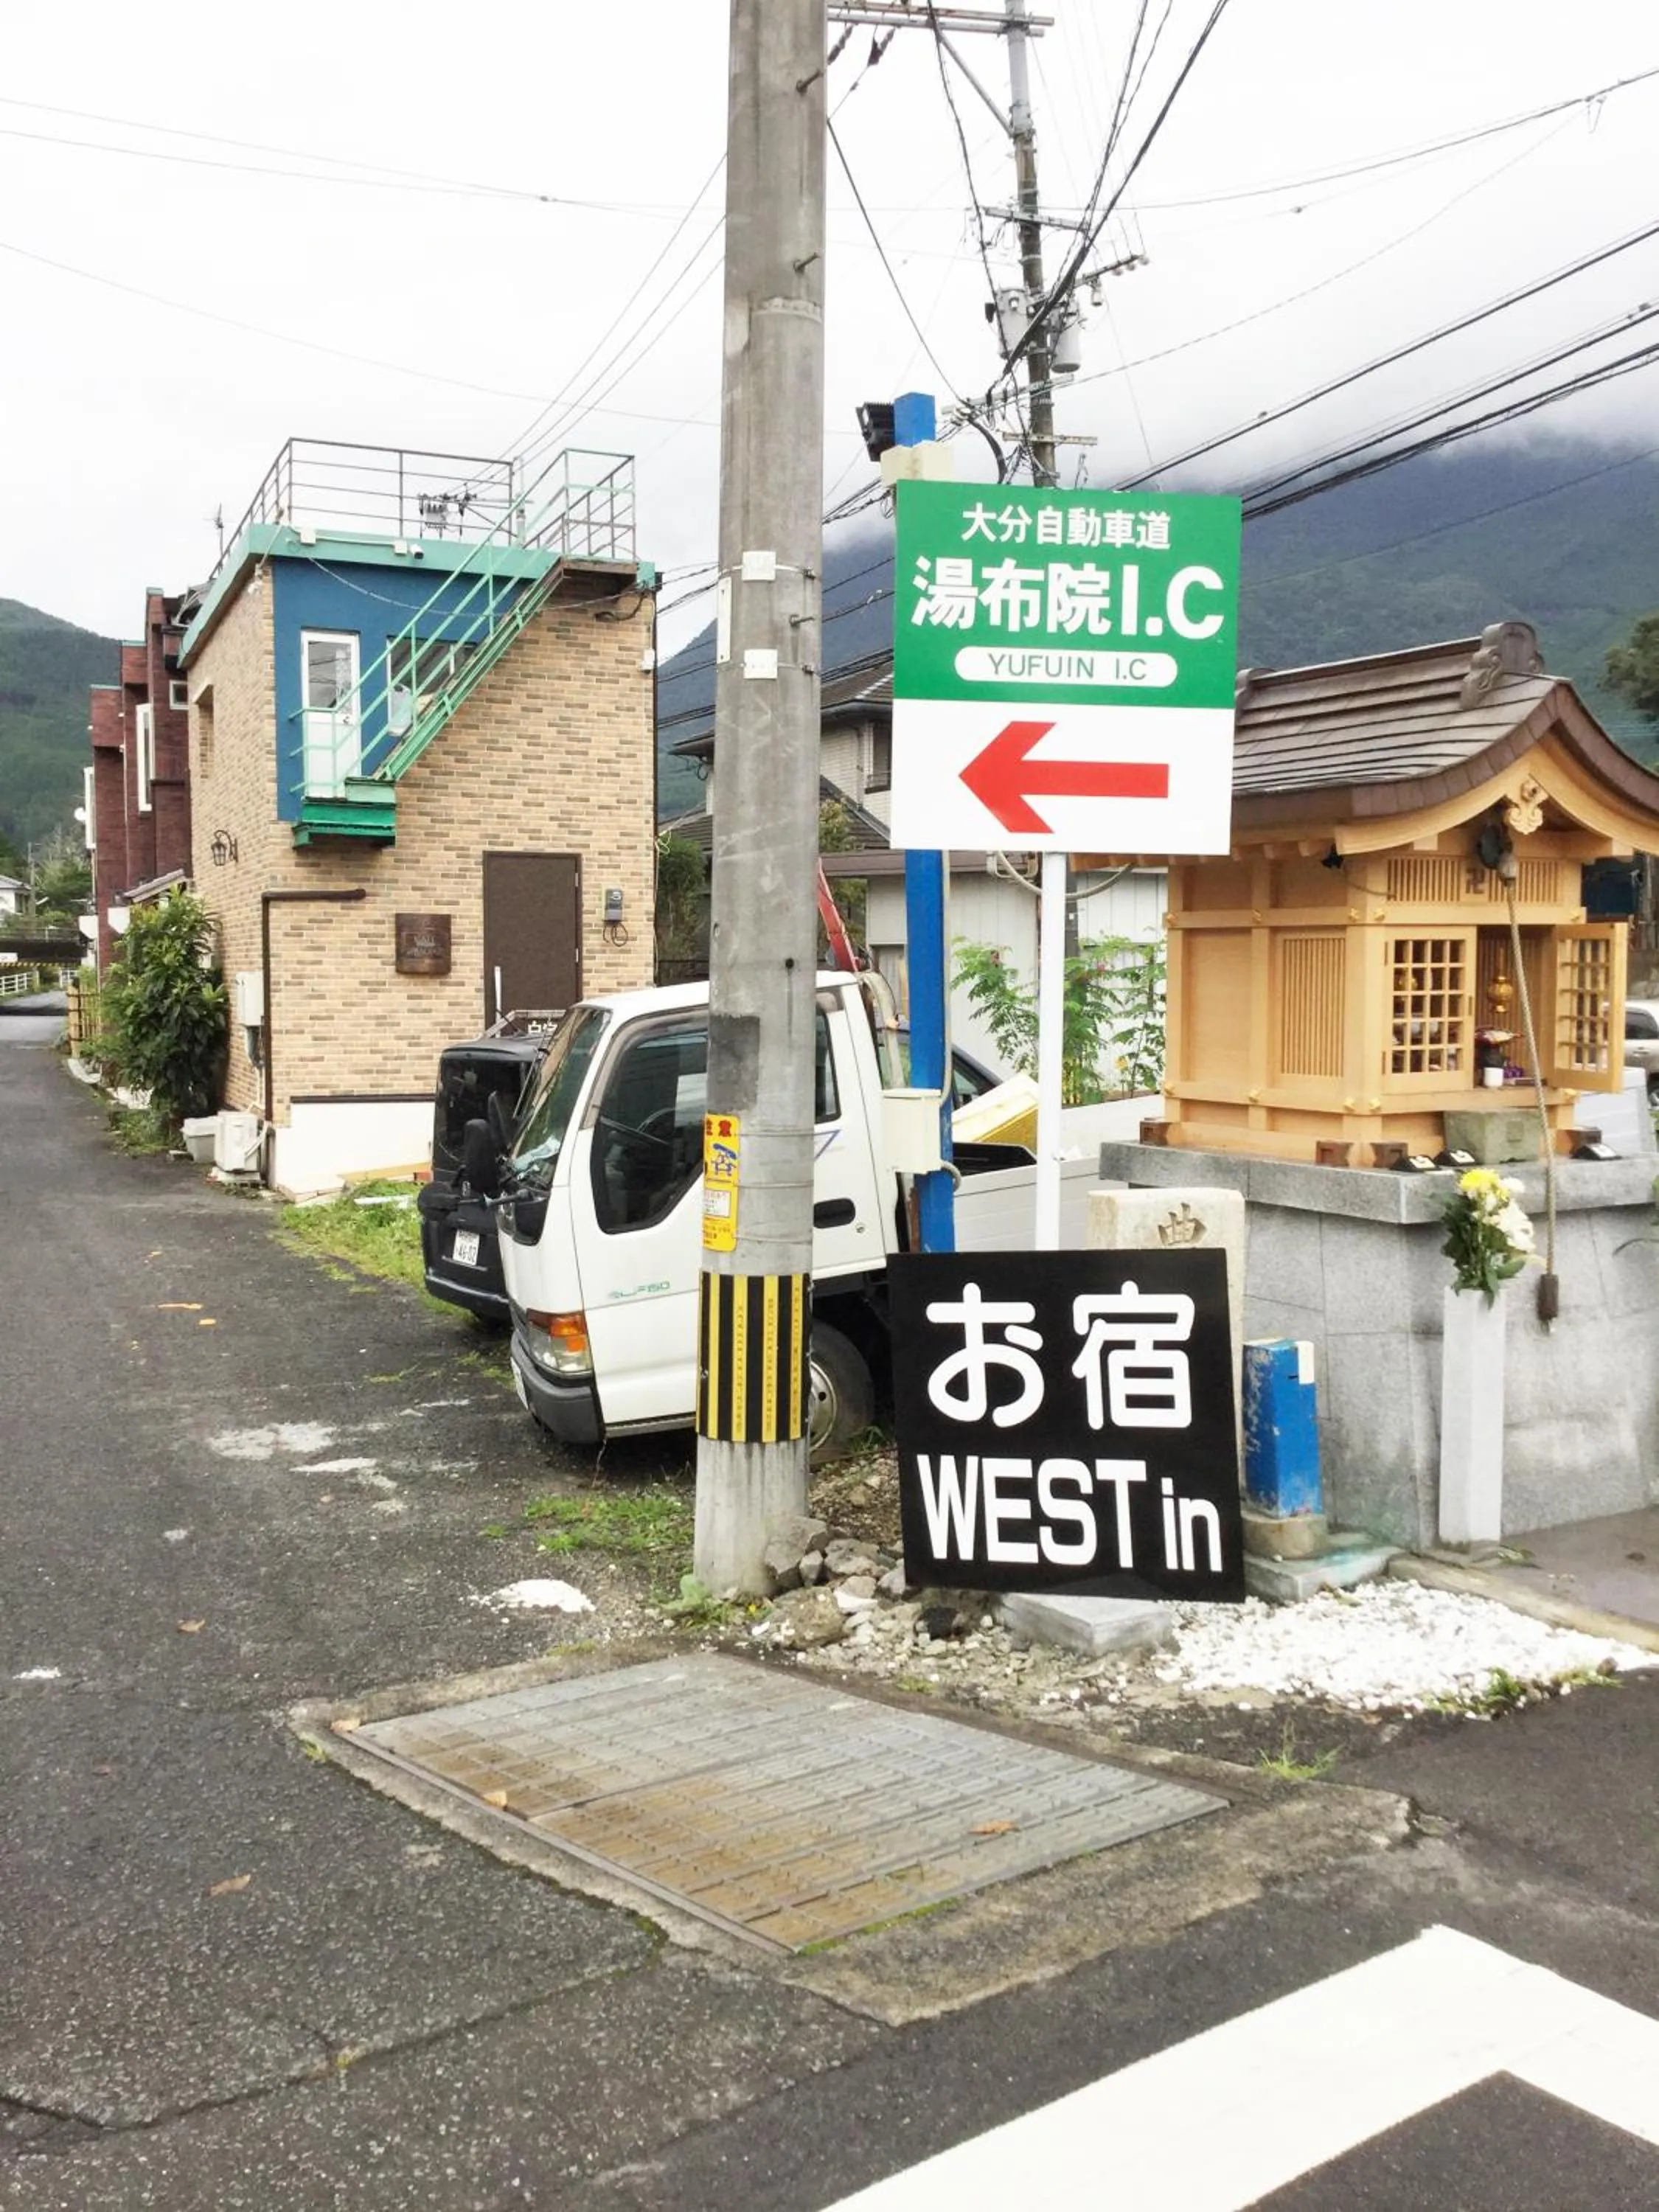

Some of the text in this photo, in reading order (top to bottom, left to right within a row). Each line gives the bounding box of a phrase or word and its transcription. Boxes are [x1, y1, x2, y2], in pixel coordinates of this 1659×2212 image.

[961, 502, 1171, 549] 大分自動車道
[911, 555, 1225, 640] 湯布院I.C
[988, 653, 1148, 681] YUFUIN I.C
[925, 1279, 1196, 1430] お宿
[917, 1453, 1223, 1573] WEST in
